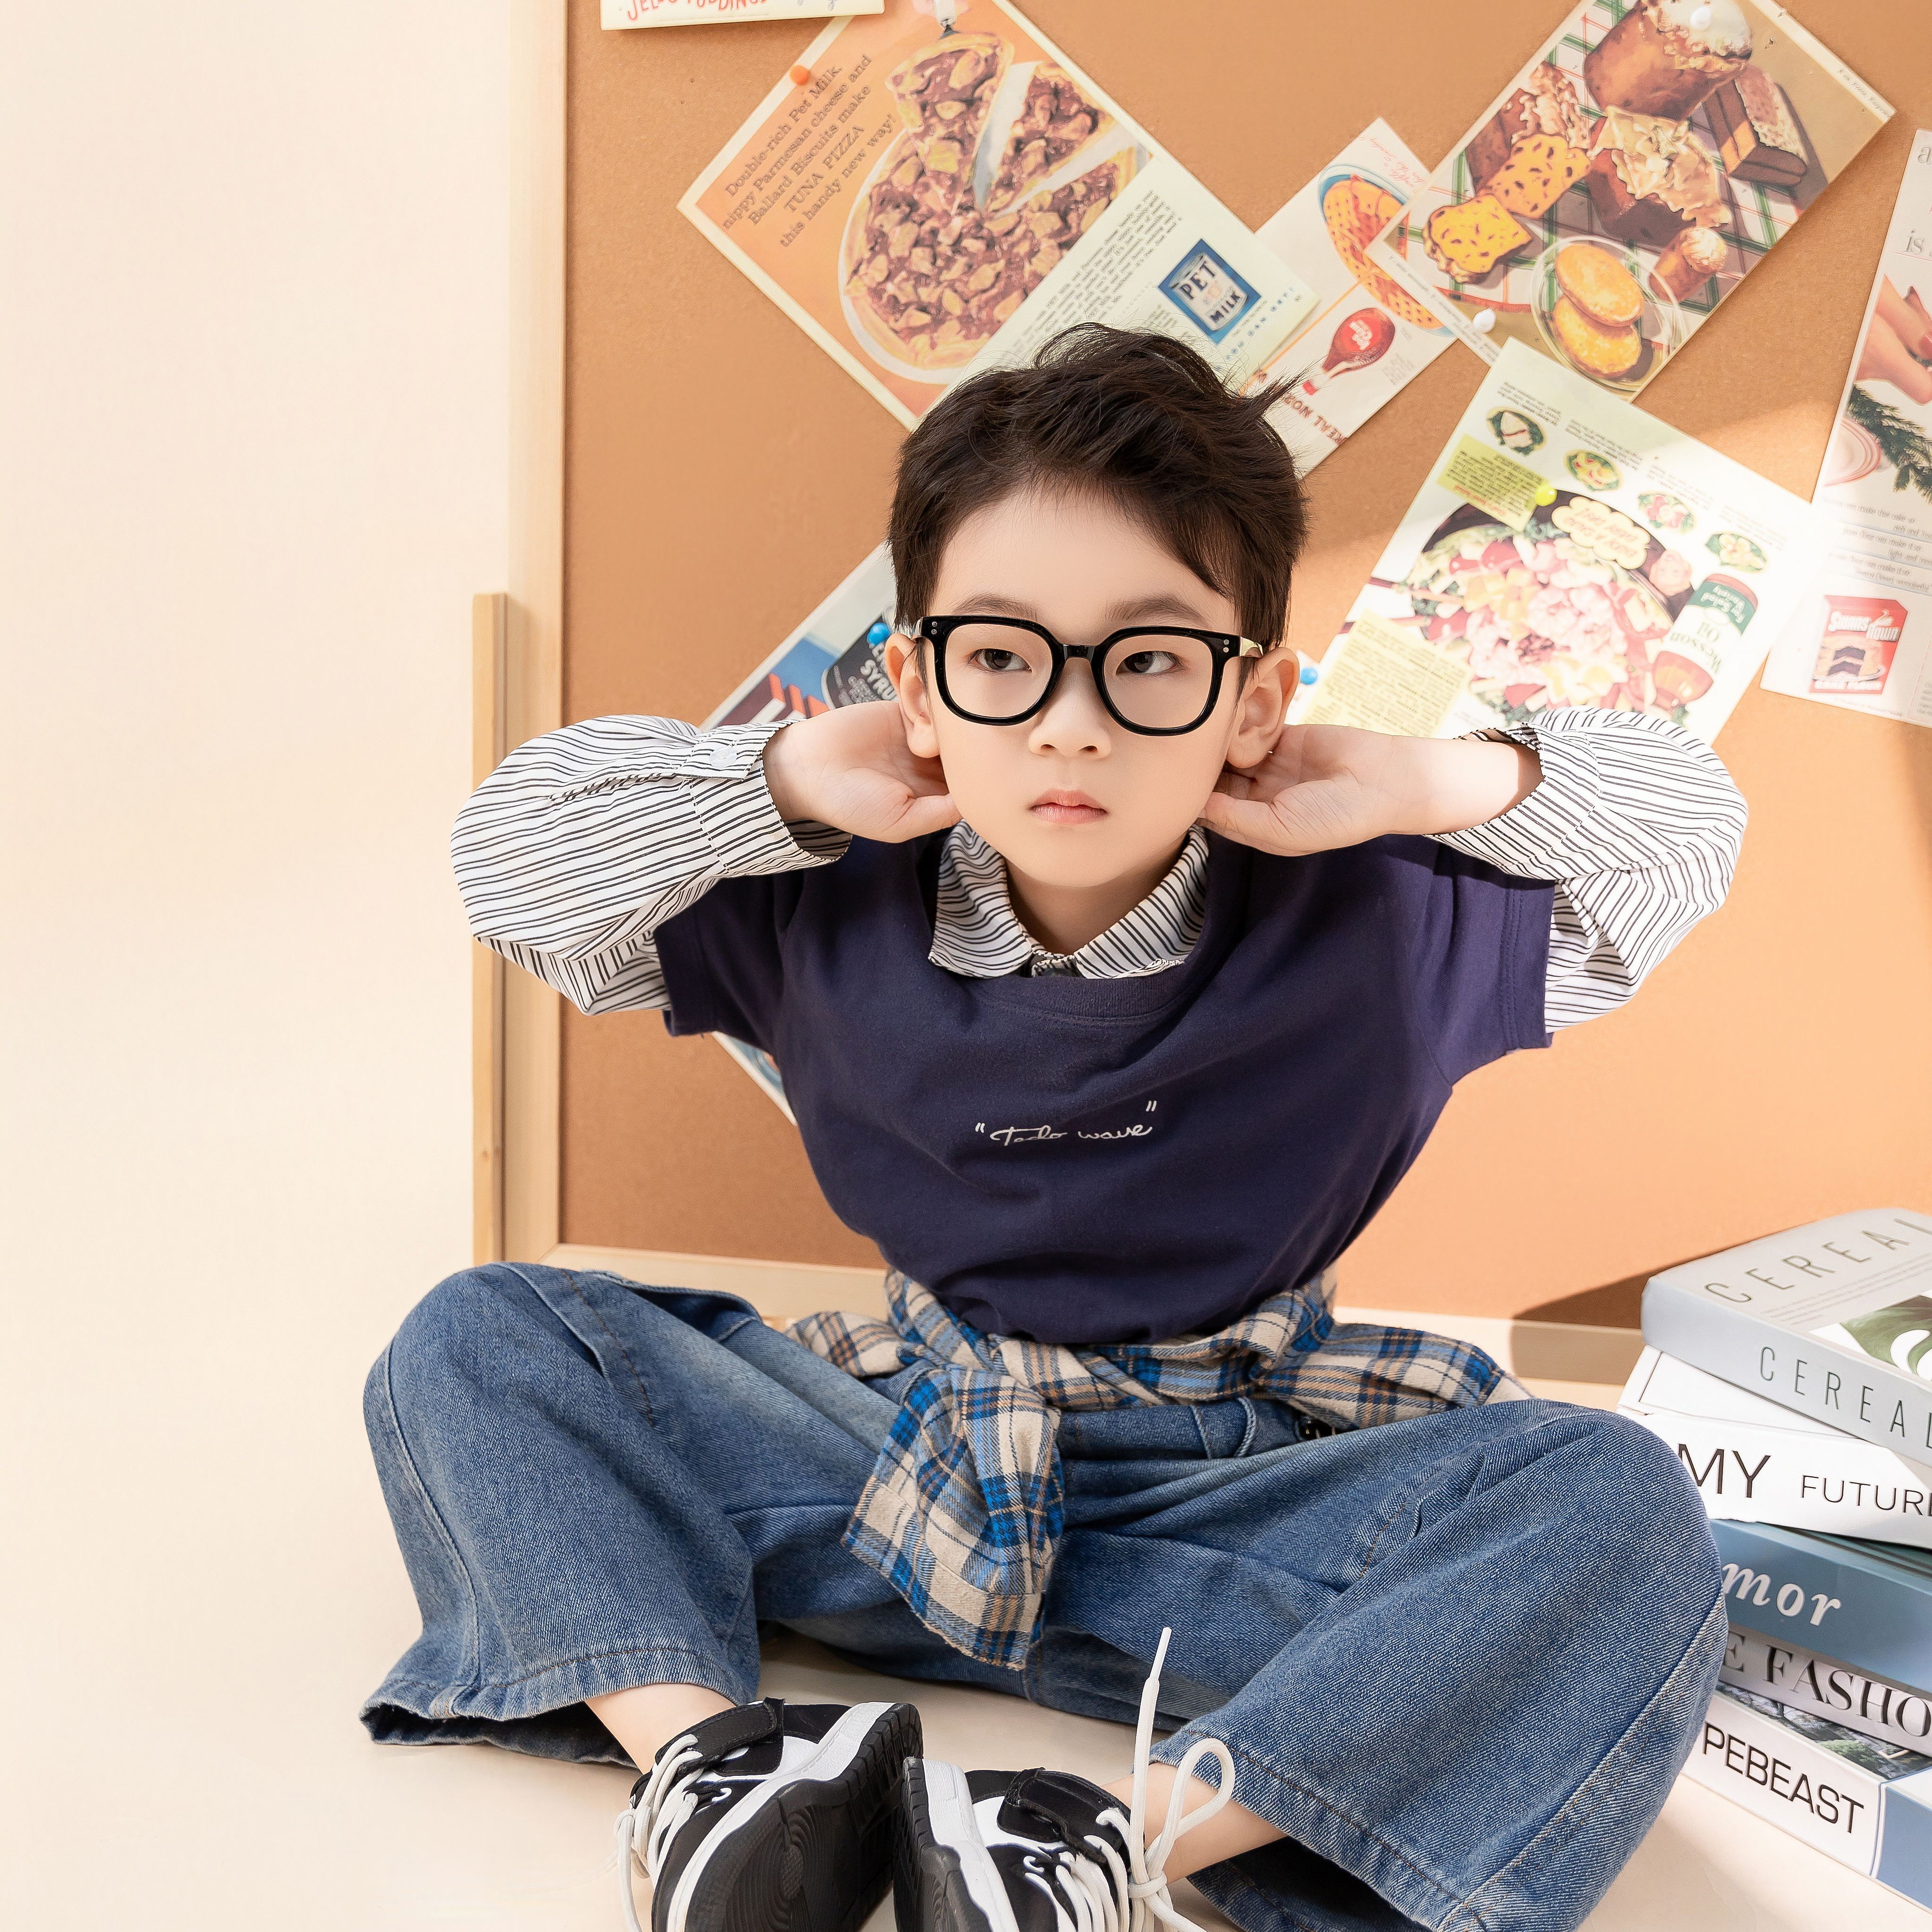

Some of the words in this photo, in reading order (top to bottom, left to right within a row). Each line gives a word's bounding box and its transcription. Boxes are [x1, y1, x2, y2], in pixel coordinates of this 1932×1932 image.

[723, 191, 755, 230] nippy
[753, 128, 812, 192] Parmesan
[811, 83, 849, 127] cheese
[848, 54, 872, 82] and
[725, 123, 792, 197] Double-rich
[790, 98, 812, 123] Pet
[748, 175, 793, 225] Ballard
[791, 125, 838, 176] Biscuits
[838, 85, 871, 123] make
[784, 173, 824, 212] TUNA
[822, 126, 865, 170] PIZZA
[780, 221, 805, 247] this
[802, 177, 842, 221] handy
[842, 149, 867, 178] new
[1903, 230, 1925, 255] is
[1180, 261, 1215, 300] PET
[1210, 291, 1240, 323] MILK
[860, 659, 898, 700] SYRU
[1759, 1345, 1932, 1449] CEREAL
[1677, 1443, 1771, 1498] MY
[1801, 1475, 1932, 1517] FUTUR
[1762, 1644, 1931, 1736] FASHO
[1702, 1722, 1864, 1834] PEBEAST
